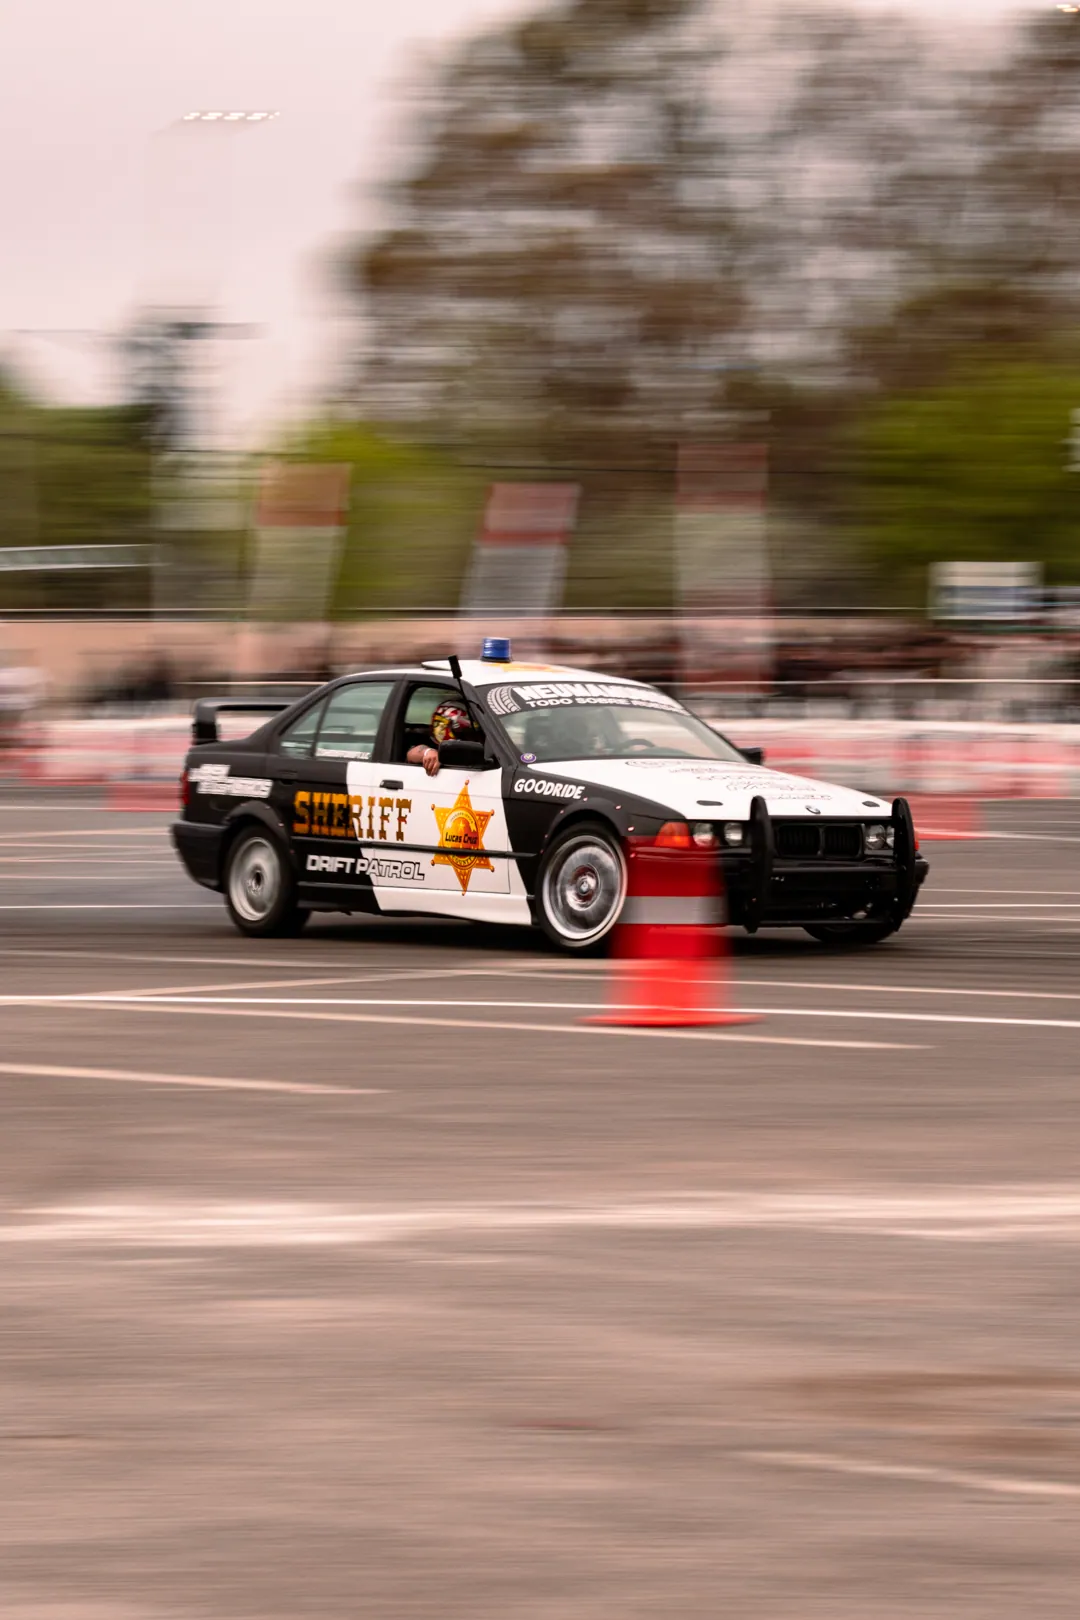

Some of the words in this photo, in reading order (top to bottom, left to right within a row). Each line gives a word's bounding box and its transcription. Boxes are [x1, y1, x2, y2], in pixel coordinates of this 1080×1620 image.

[526, 697, 573, 708] TODO
[514, 778, 586, 800] GOODRIDE
[293, 790, 412, 842] SHERIFF
[306, 854, 356, 875] DRIFT
[355, 857, 426, 881] PATROL
